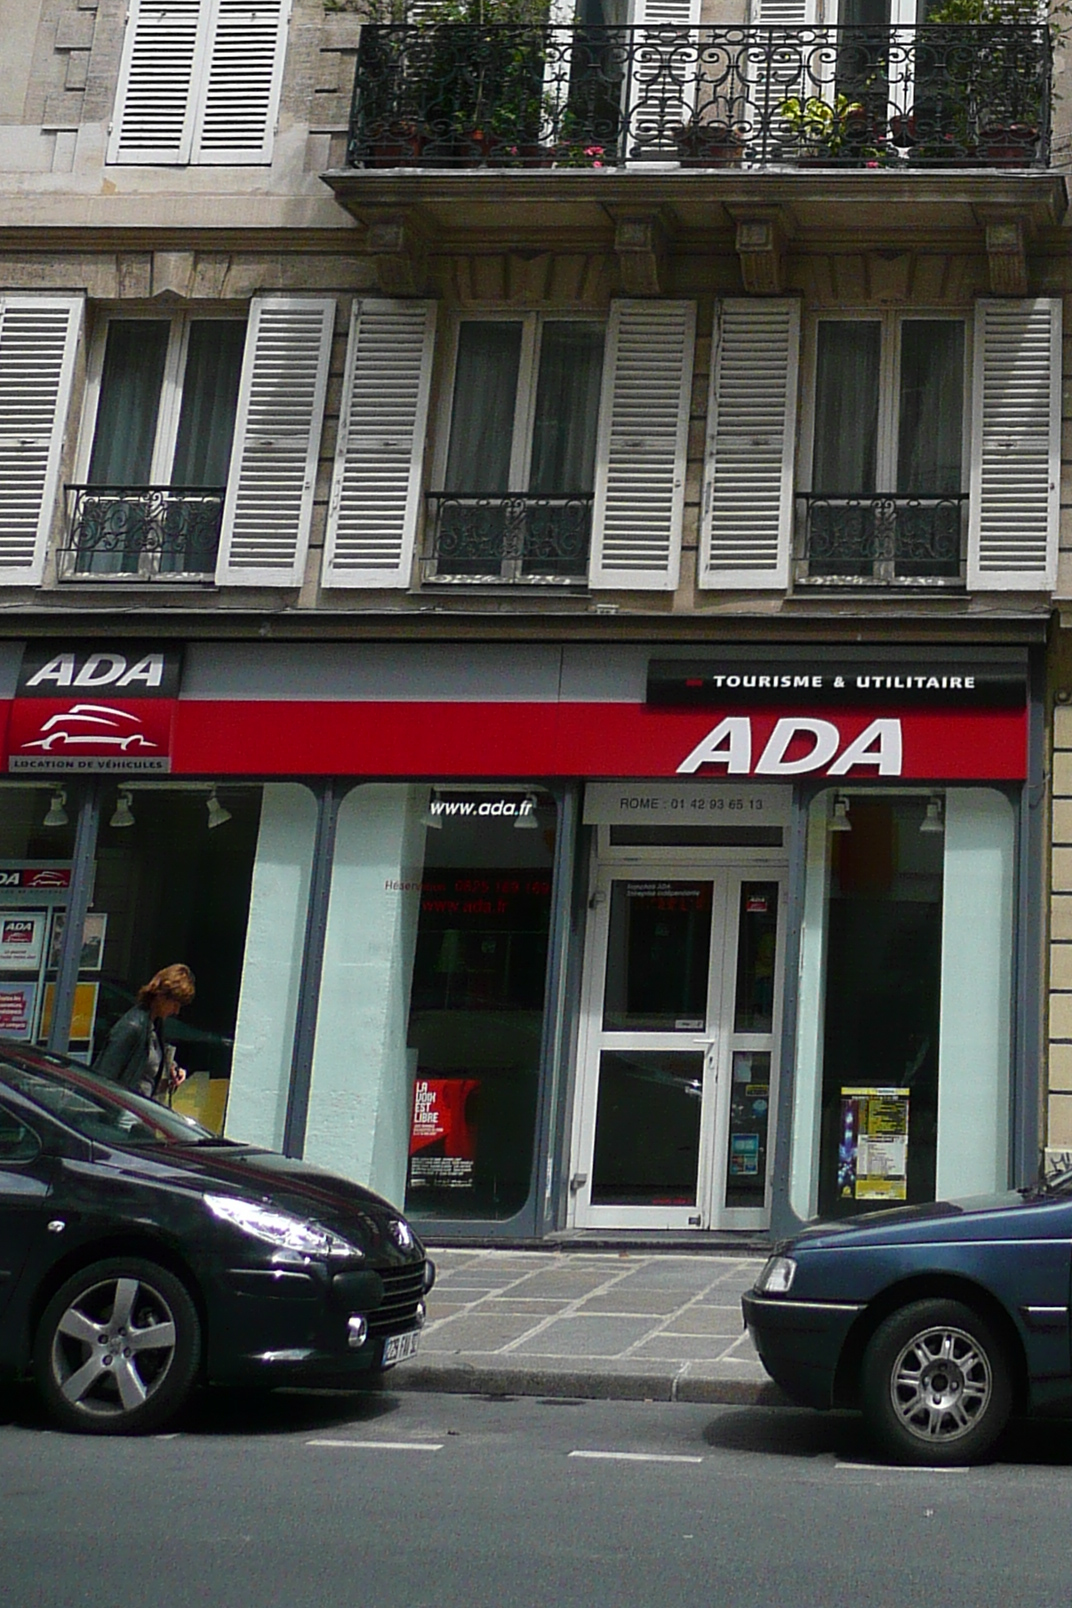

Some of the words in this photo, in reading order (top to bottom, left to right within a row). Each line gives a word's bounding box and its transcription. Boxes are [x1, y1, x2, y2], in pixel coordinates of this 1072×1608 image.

[25, 653, 164, 686] ADA
[713, 675, 823, 688] TOURISME
[834, 676, 845, 688] &
[856, 676, 975, 689] UTILITAIRE
[675, 716, 902, 776] ADA
[14, 760, 74, 768] LOCATION
[78, 760, 93, 768] DE
[98, 758, 163, 769] VÉHICULES
[430, 799, 533, 816] www.ada.fr
[620, 797, 659, 810] ROME
[671, 799, 685, 810] 01
[690, 799, 705, 810] 42
[709, 799, 724, 810] 93
[749, 799, 763, 810] 13
[5, 922, 32, 931] ADA
[416, 1081, 428, 1092] LA
[415, 1103, 432, 1113] EST
[414, 1112, 439, 1123] LIBRE
